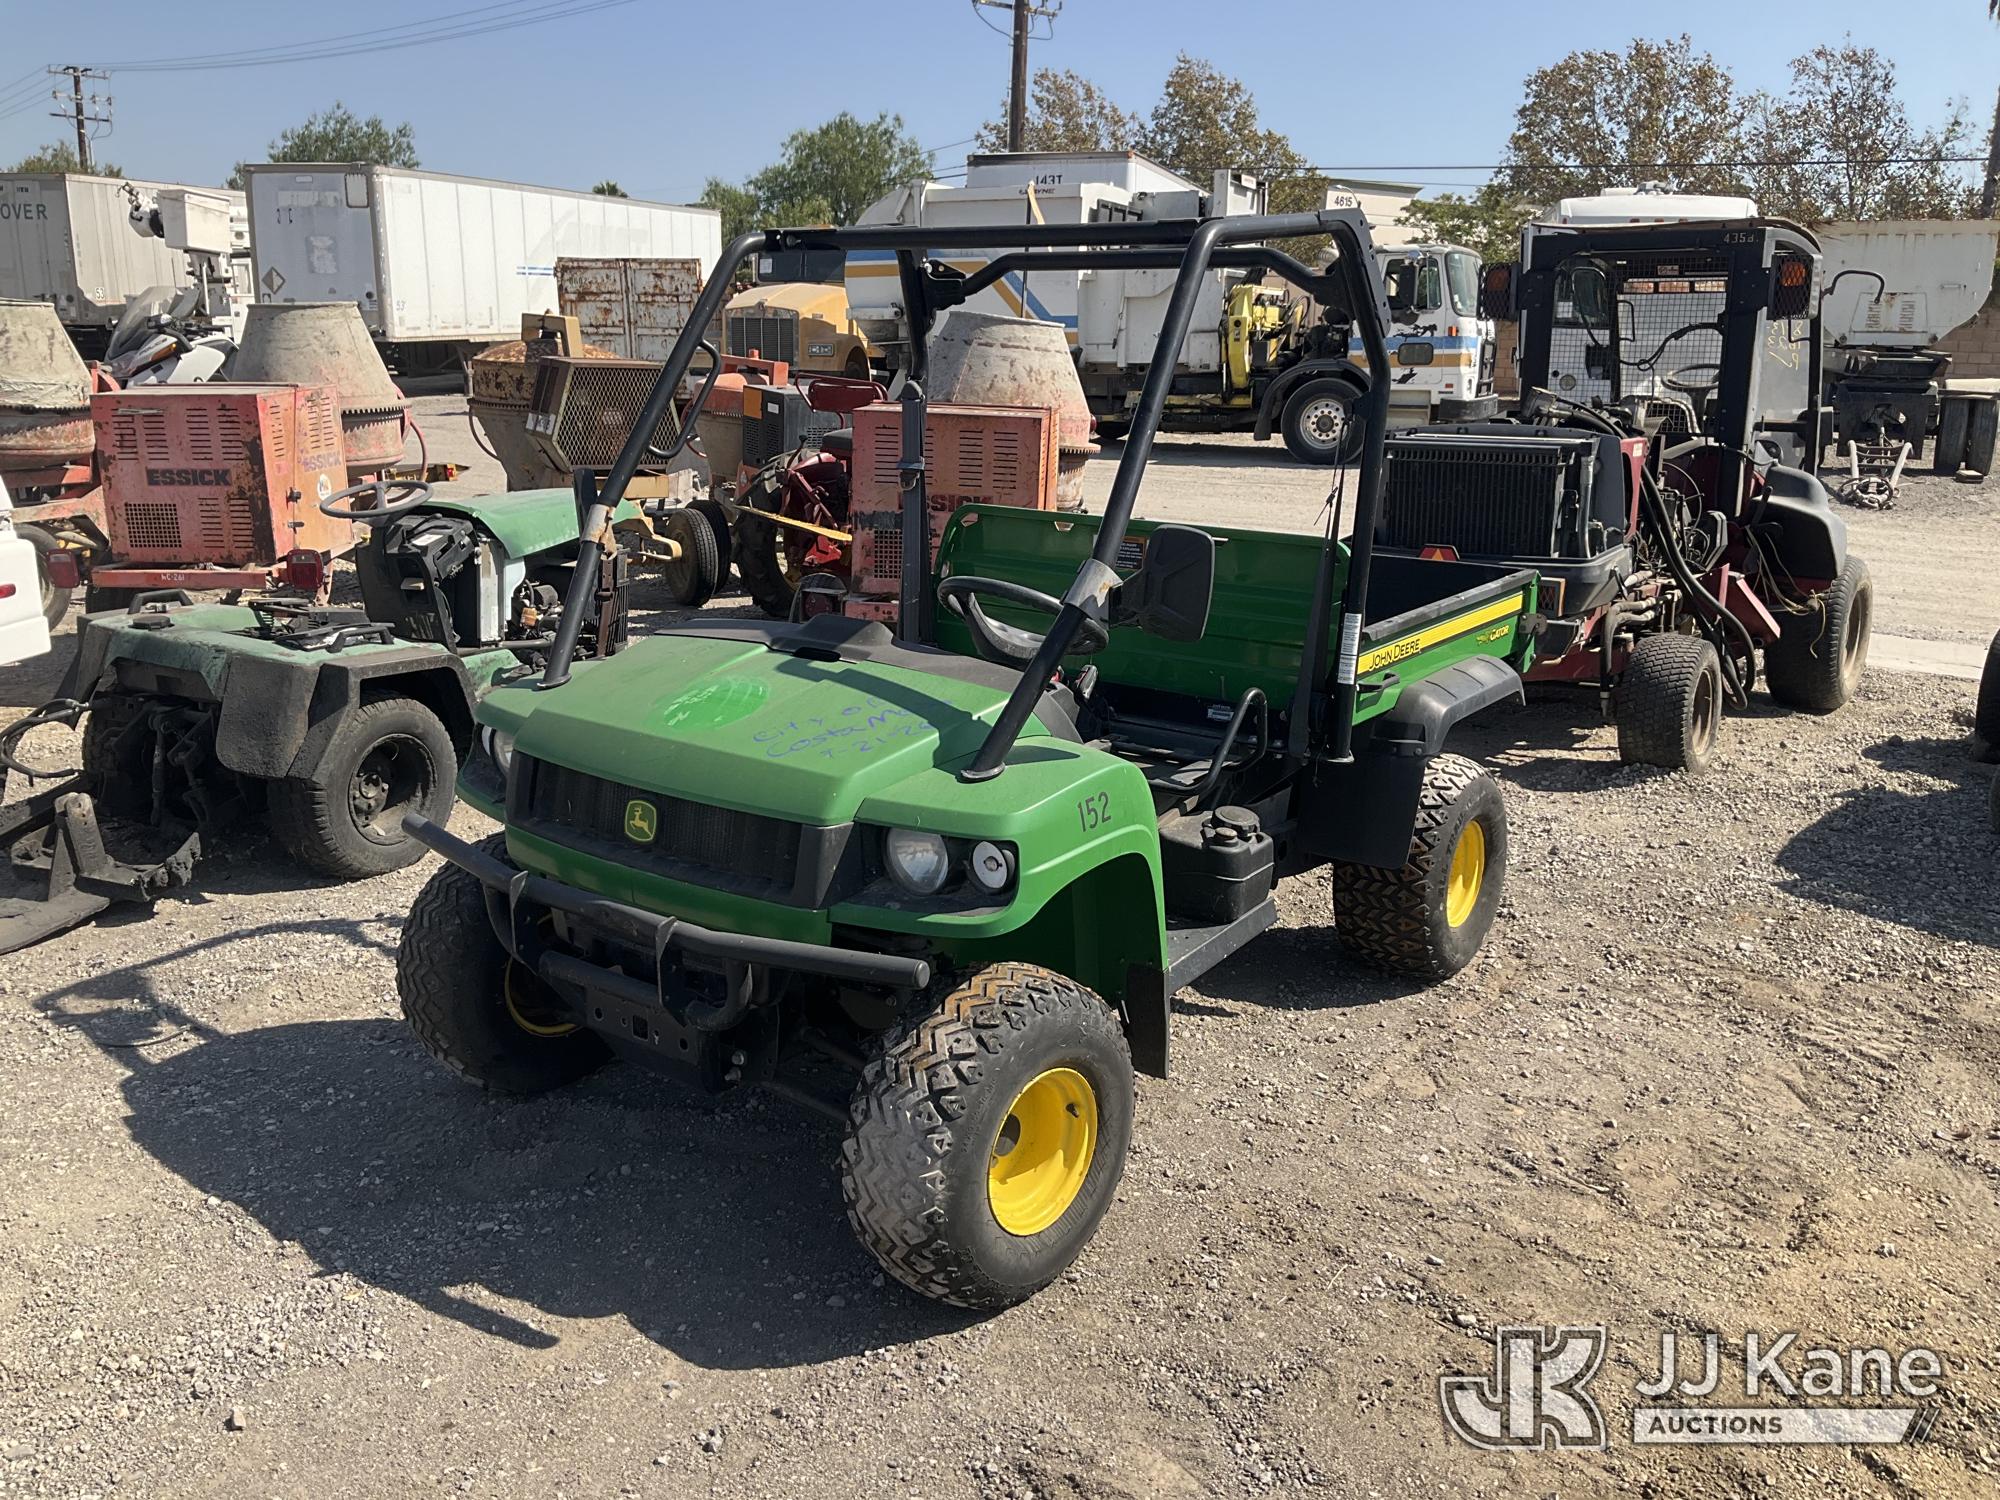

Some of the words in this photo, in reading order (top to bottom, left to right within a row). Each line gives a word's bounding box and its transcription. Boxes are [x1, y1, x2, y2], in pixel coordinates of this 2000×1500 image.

[1334, 196, 1353, 207] 4615
[0, 203, 48, 220] OVER
[147, 469, 231, 486] ESSICK
[1369, 651, 1393, 671] JOHN
[1393, 639, 1421, 660] DEERE
[1077, 791, 1111, 832] 152
